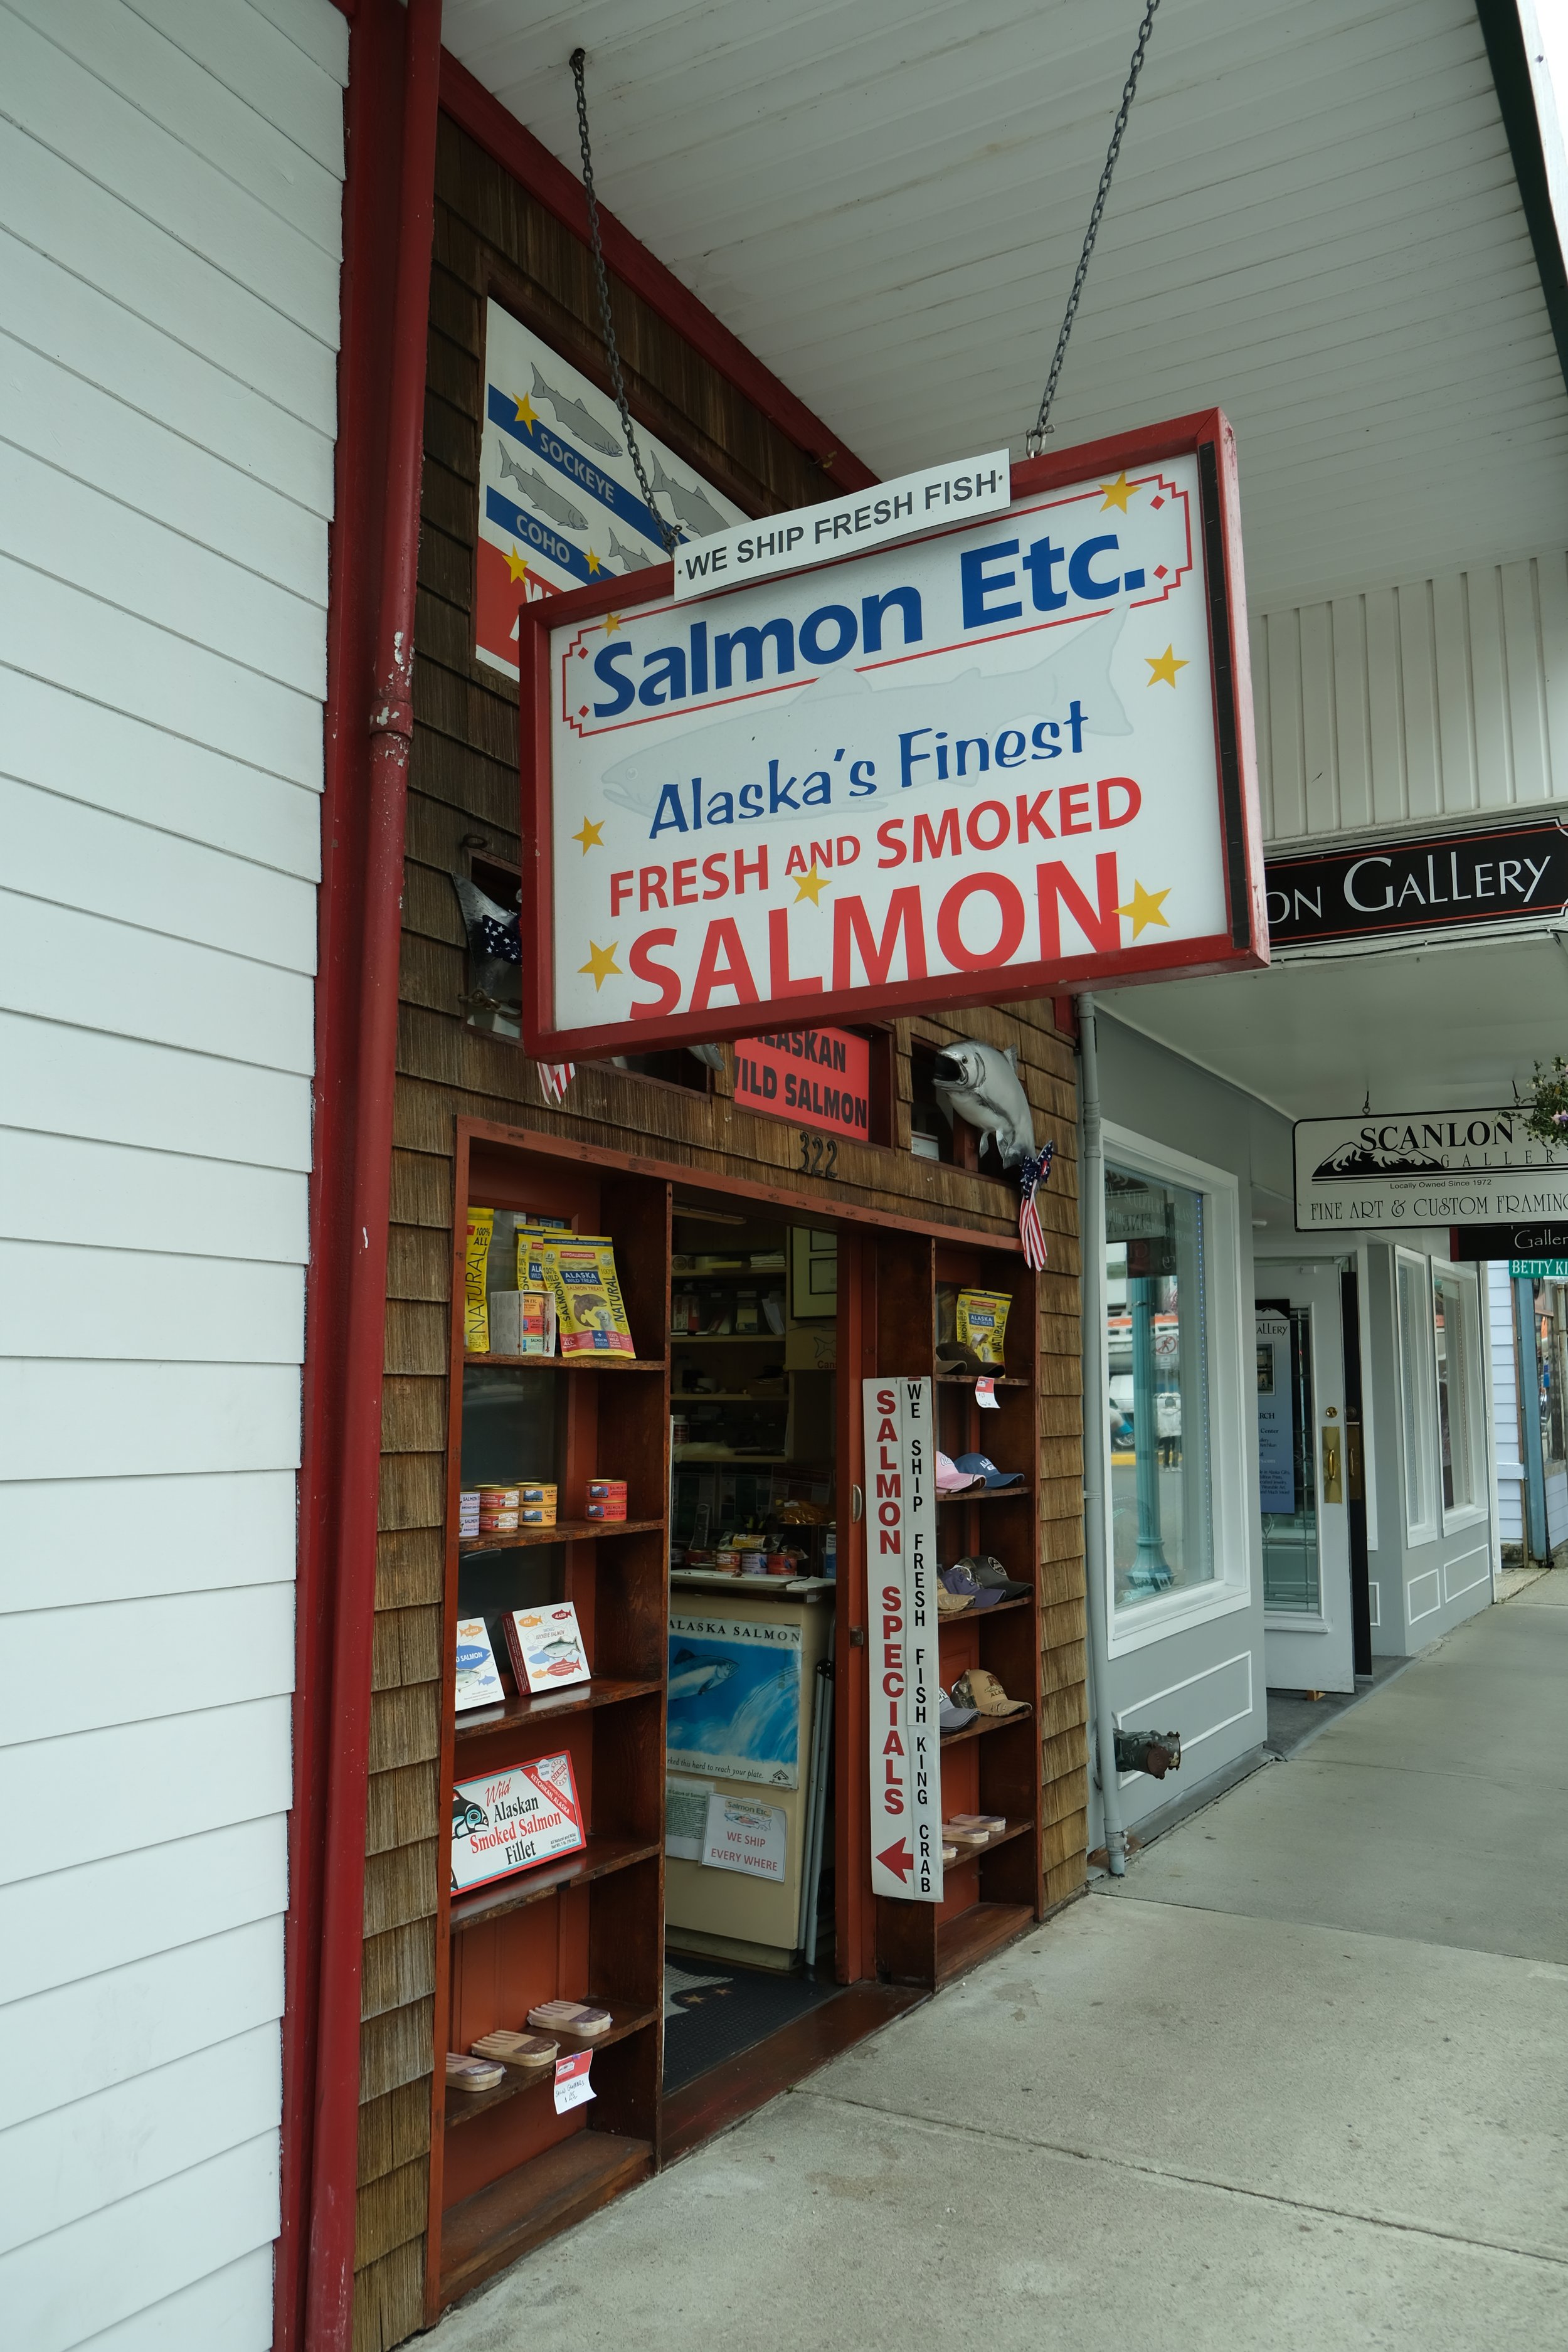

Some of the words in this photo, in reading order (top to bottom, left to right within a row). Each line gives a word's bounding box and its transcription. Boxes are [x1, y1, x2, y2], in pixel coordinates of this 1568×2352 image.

[541, 433, 615, 504] SOCKEYE
[516, 514, 570, 564] COHO
[685, 547, 728, 581] WE
[736, 526, 805, 565] SHIP
[813, 490, 914, 544] FRESH
[924, 469, 1000, 512] FISH
[592, 585, 924, 719] Salmon
[961, 533, 1147, 631] Etc.
[649, 748, 877, 840] Alaska's
[898, 700, 1089, 789] Finest
[610, 844, 770, 918] FRESH
[783, 834, 862, 877] AND
[876, 776, 1143, 870] SMOKED
[1343, 850, 1552, 913] GALLERY
[628, 851, 1123, 1022] SALMON
[750, 1029, 846, 1074] LASKAN
[785, 1073, 867, 1130] SALMON
[798, 1131, 839, 1179] 322
[1360, 1119, 1515, 1151] SCANLON
[1441, 1148, 1568, 1169] GALLER
[1389, 1182, 1417, 1190] Locally
[1419, 1180, 1446, 1189] Owned
[1448, 1179, 1470, 1187] Since
[1311, 1202, 1343, 1221] FINE
[1349, 1200, 1384, 1219] ART
[1391, 1199, 1407, 1218] &
[1413, 1195, 1489, 1217] CUSTOM
[474, 1237, 488, 1246] ALL
[476, 1227, 490, 1236] 100%
[544, 1274, 559, 1282] WILD
[1512, 1259, 1553, 1274] BETTY
[465, 1247, 487, 1333] NATURAL
[554, 1281, 571, 1322] SALMON
[605, 1275, 627, 1323] NATURAL
[992, 1320, 1005, 1353] NATURAL
[907, 1384, 922, 1419] WE
[876, 1389, 901, 1555] SALMON
[911, 1439, 923, 1513] SHIP
[913, 1534, 926, 1627] FRESH
[535, 1632, 551, 1640] SOCKEYE
[550, 1629, 565, 1638] SALMON
[670, 1619, 726, 1634] ALASKA
[733, 1626, 801, 1642] SALMON
[460, 1651, 483, 1662] SALMON
[882, 1586, 905, 1816] SPECIALS
[915, 1648, 927, 1724] FISH
[681, 1759, 691, 1767] this
[692, 1761, 706, 1770] hard
[714, 1766, 731, 1774] reach
[731, 1768, 746, 1777] your
[747, 1769, 764, 1779] plate.
[916, 1736, 928, 1806] KING
[485, 1777, 512, 1808] Wild
[494, 1796, 539, 1823] Alaskan
[531, 1773, 554, 1801] KETCHIKAN,
[553, 1798, 570, 1815] ALASKA
[728, 1801, 755, 1814] Salmon
[756, 1808, 770, 1816] Etc.
[470, 1821, 517, 1854] Smoked
[519, 1811, 562, 1838] Salmon
[505, 1840, 537, 1865] Fillet
[554, 1836, 564, 1844] Natural
[727, 1831, 743, 1843] WE
[744, 1835, 766, 1848] SHIP
[711, 1848, 742, 1863] EVERY
[743, 1854, 778, 1872] WHERE
[919, 1824, 931, 1893] CRAB
